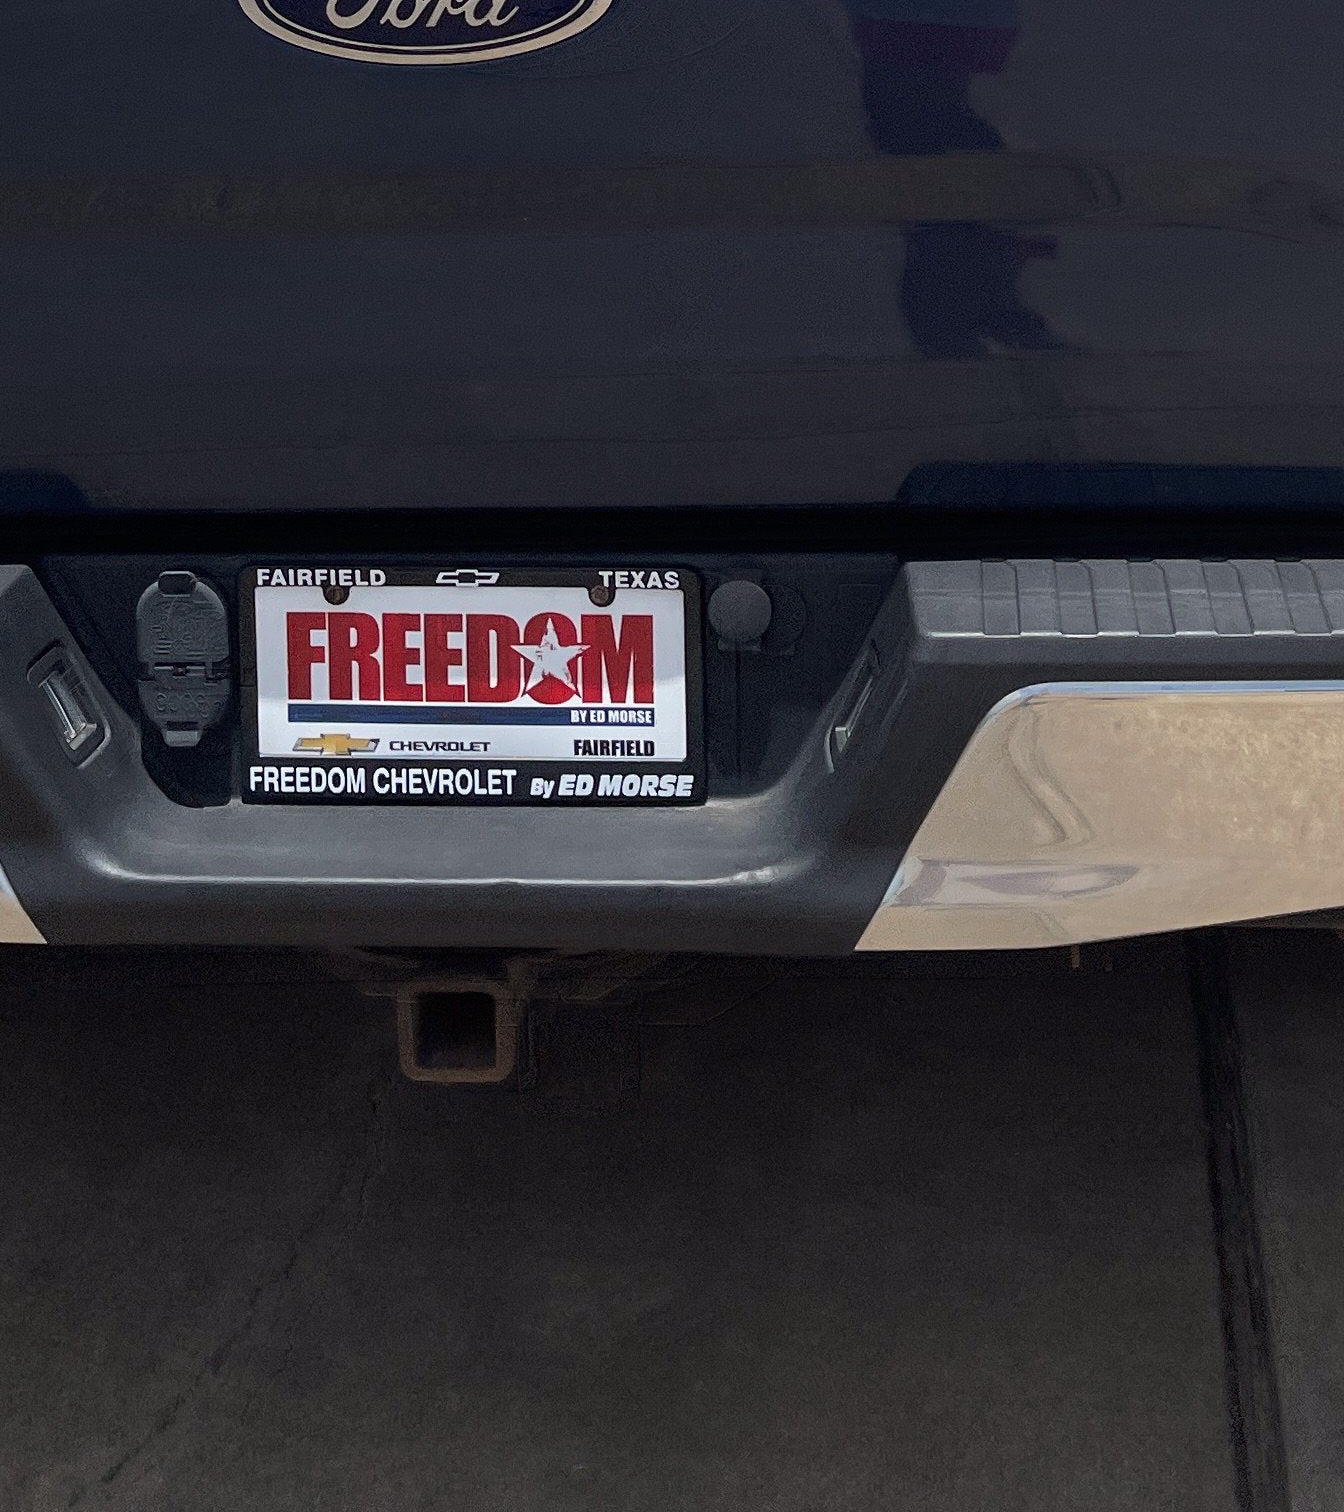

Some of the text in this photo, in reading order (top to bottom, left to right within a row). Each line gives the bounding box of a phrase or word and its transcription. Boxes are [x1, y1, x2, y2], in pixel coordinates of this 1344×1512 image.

[256, 569, 387, 587] FAIRFIELD
[599, 571, 680, 589] TEXAS
[286, 611, 655, 705] FREEDOM
[570, 710, 652, 724] BY ED MORSE
[389, 741, 492, 753] CHEVROLET
[574, 739, 655, 757] FAIRFIELD
[249, 766, 694, 799] FREEDOM CHEVROLET By ED MORSE
